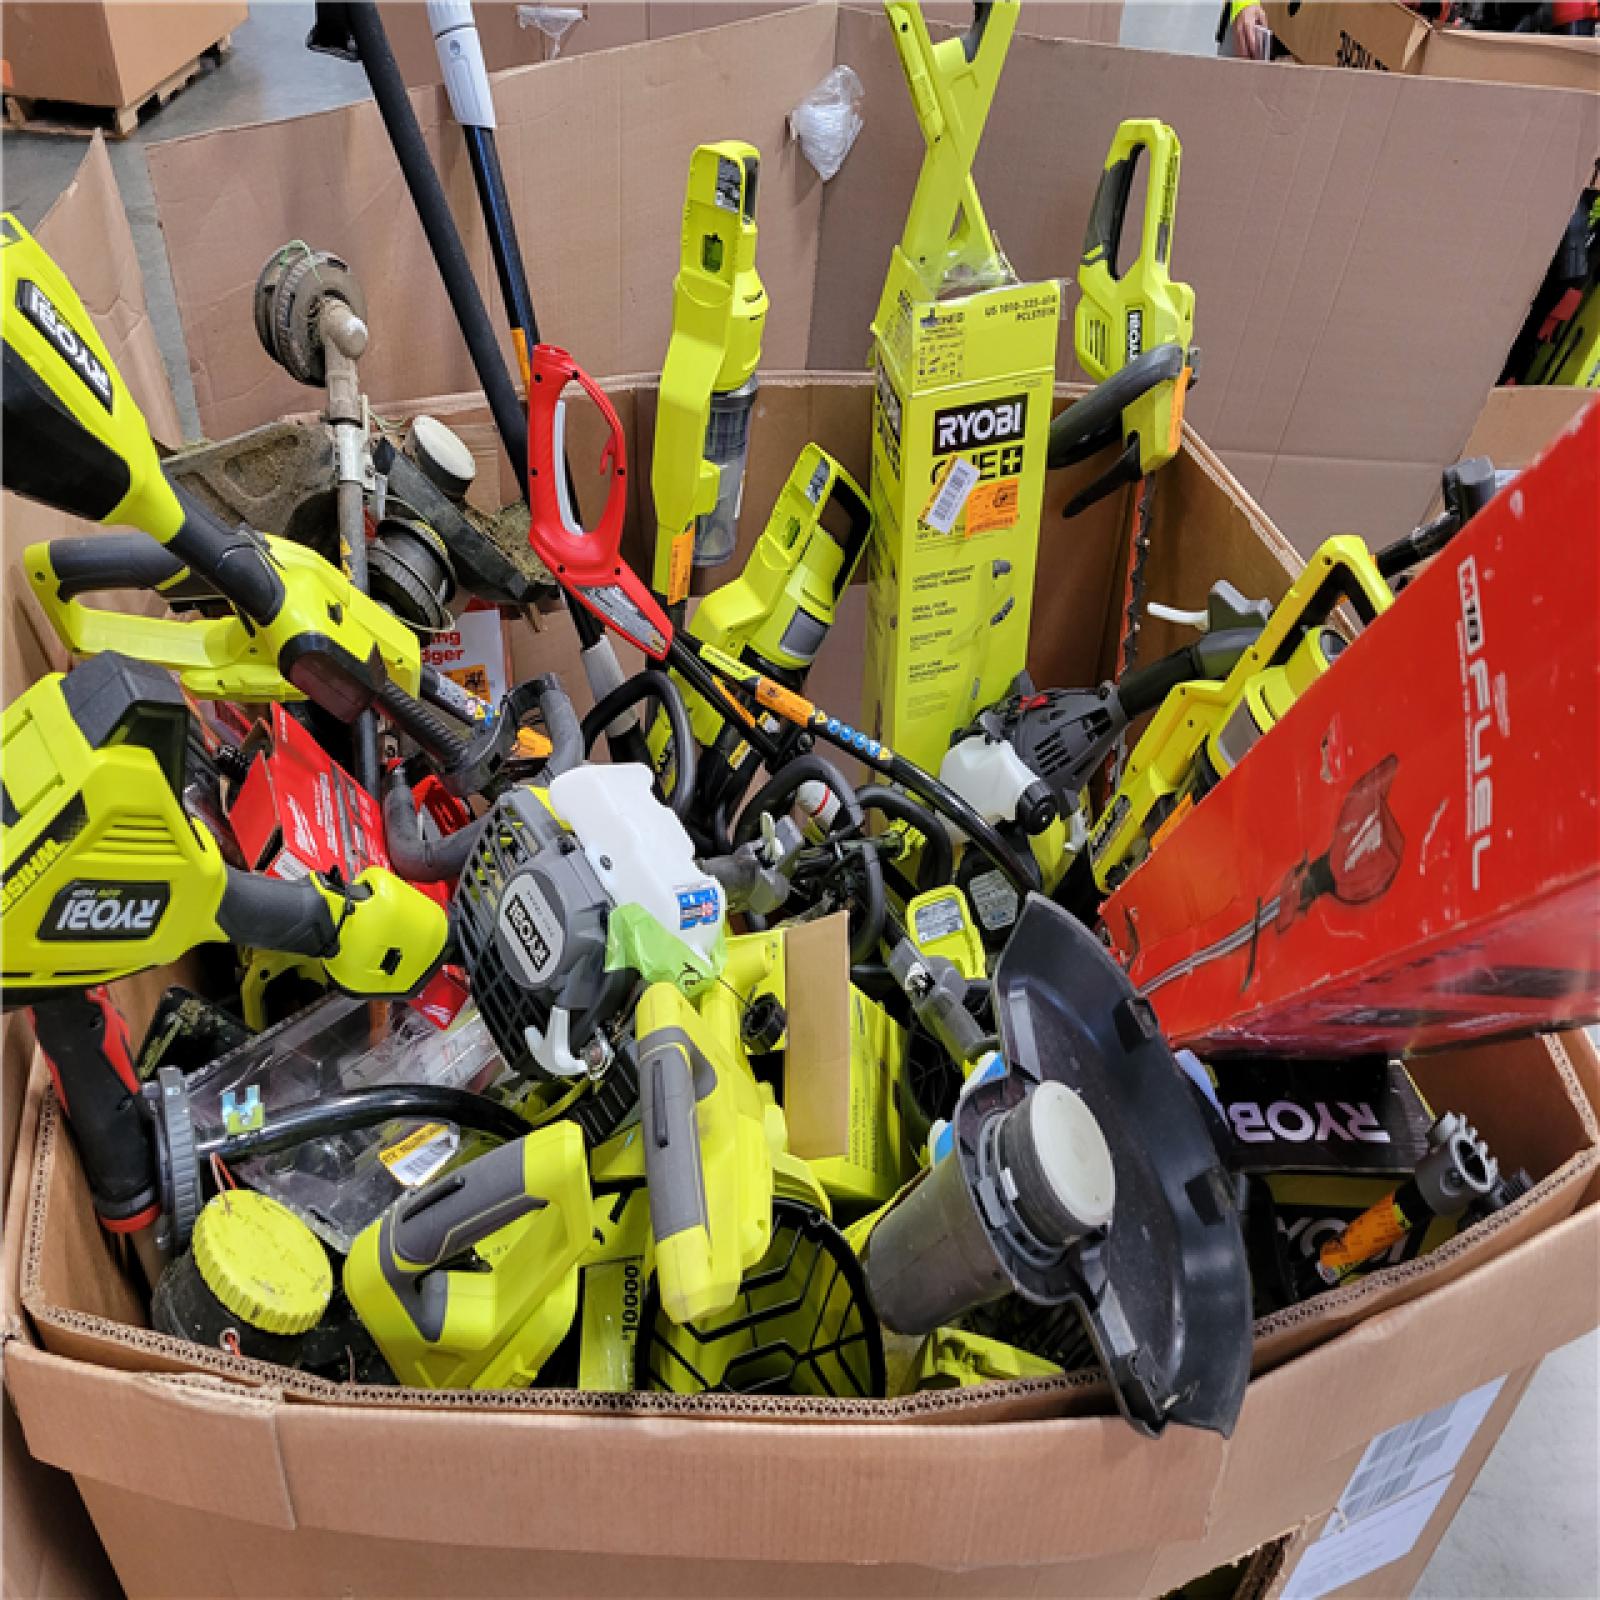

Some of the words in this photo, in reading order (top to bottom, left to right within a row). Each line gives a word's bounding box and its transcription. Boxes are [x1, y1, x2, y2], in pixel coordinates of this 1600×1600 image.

[31, 284, 111, 396] RYOBI
[938, 402, 1022, 448] RYOBI
[1458, 556, 1485, 655] M18
[1468, 658, 1493, 891] FUEL
[55, 899, 161, 930] RYOBI
[509, 900, 545, 966] RYOBI
[1228, 1102, 1391, 1142] RYOB
